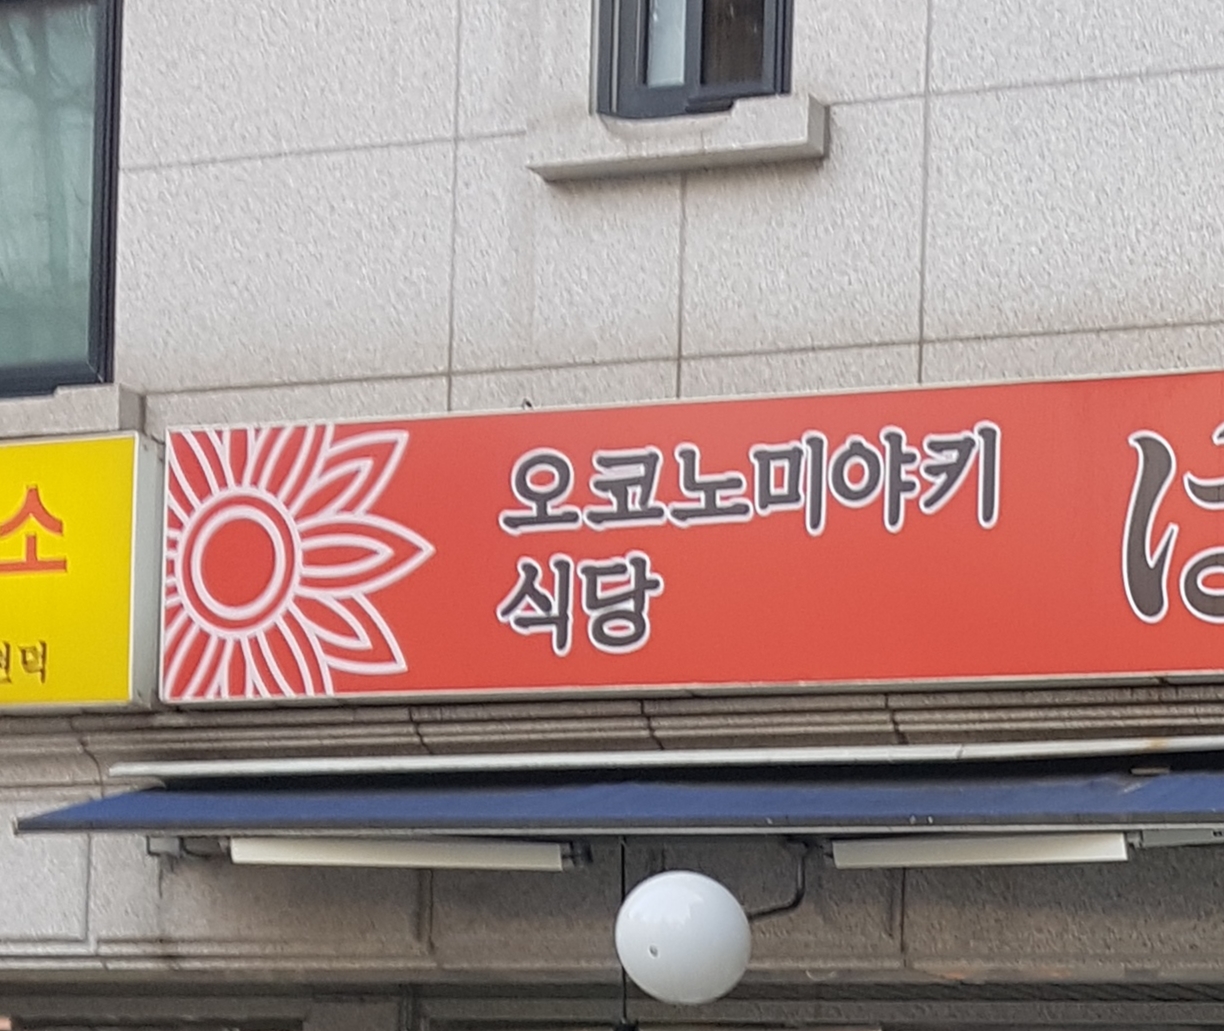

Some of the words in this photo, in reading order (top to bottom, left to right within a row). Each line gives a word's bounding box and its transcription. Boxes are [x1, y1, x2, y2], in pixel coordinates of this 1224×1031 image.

[0, 484, 68, 574] 소
[500, 421, 1000, 534] 오코노미야키
[498, 551, 663, 656] 식당
